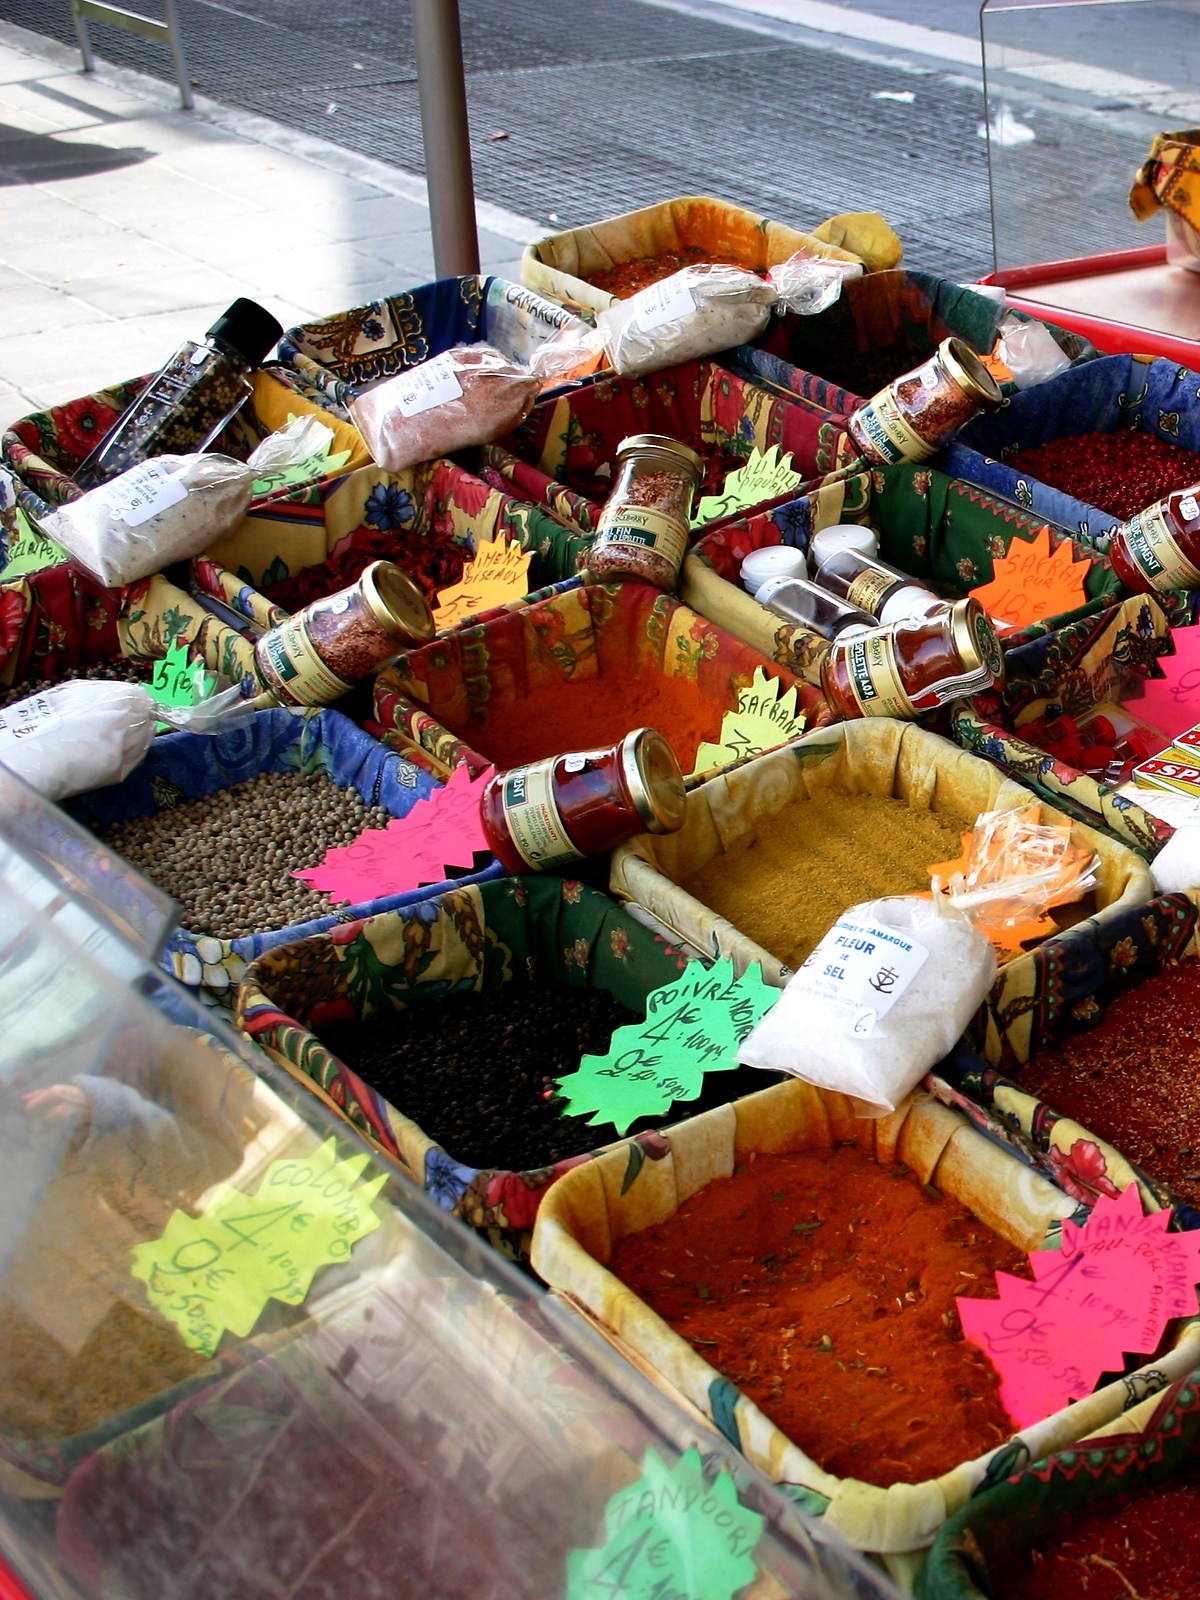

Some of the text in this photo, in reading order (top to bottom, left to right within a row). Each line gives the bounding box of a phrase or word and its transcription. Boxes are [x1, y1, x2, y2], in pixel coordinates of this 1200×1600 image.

[739, 477, 785, 496] PIQUAN
[616, 527, 632, 536] FIN
[1131, 525, 1141, 538] DE
[1136, 537, 1160, 570] PIMENT
[1003, 553, 1085, 593] SAFRAN
[834, 935, 876, 956] FLEUR
[866, 926, 914, 953] CAMARGUE
[839, 953, 850, 962] DE
[823, 964, 846, 981] SEL
[648, 976, 745, 1014] POIVRE
[269, 1163, 361, 1258] COLOMBO
[610, 1485, 753, 1559] TANDOORI
